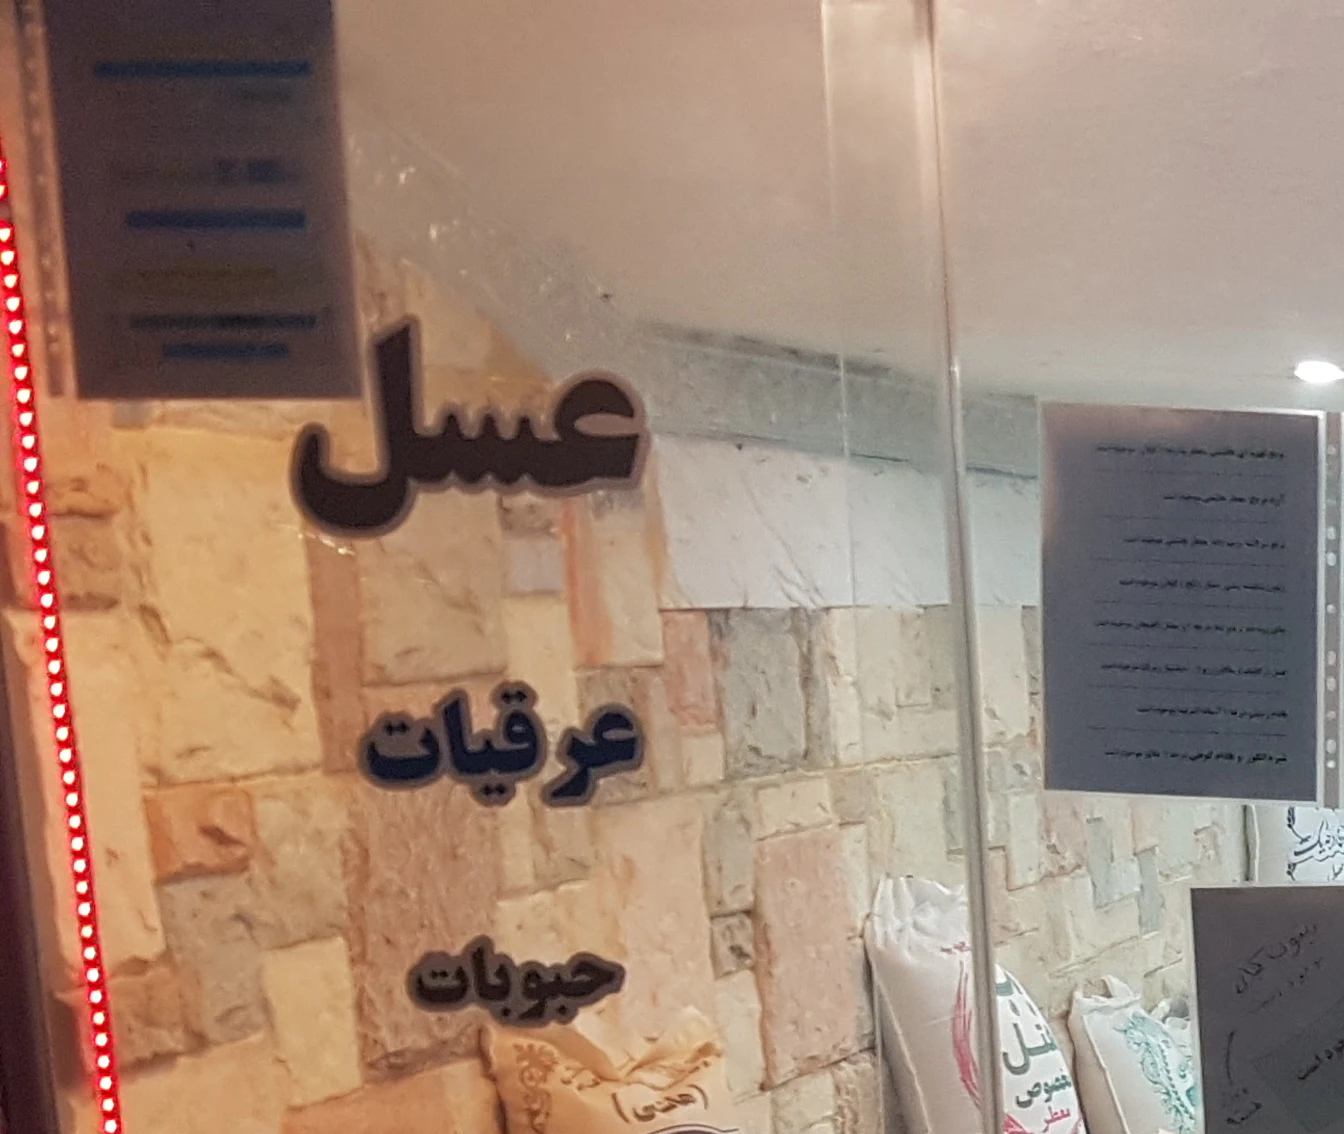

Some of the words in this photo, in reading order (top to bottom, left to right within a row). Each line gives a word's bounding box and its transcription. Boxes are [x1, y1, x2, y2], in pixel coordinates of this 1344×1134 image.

[296, 321, 645, 531] عسل
[365, 684, 638, 799] عرقیات
[413, 941, 620, 1023] حبوبات
